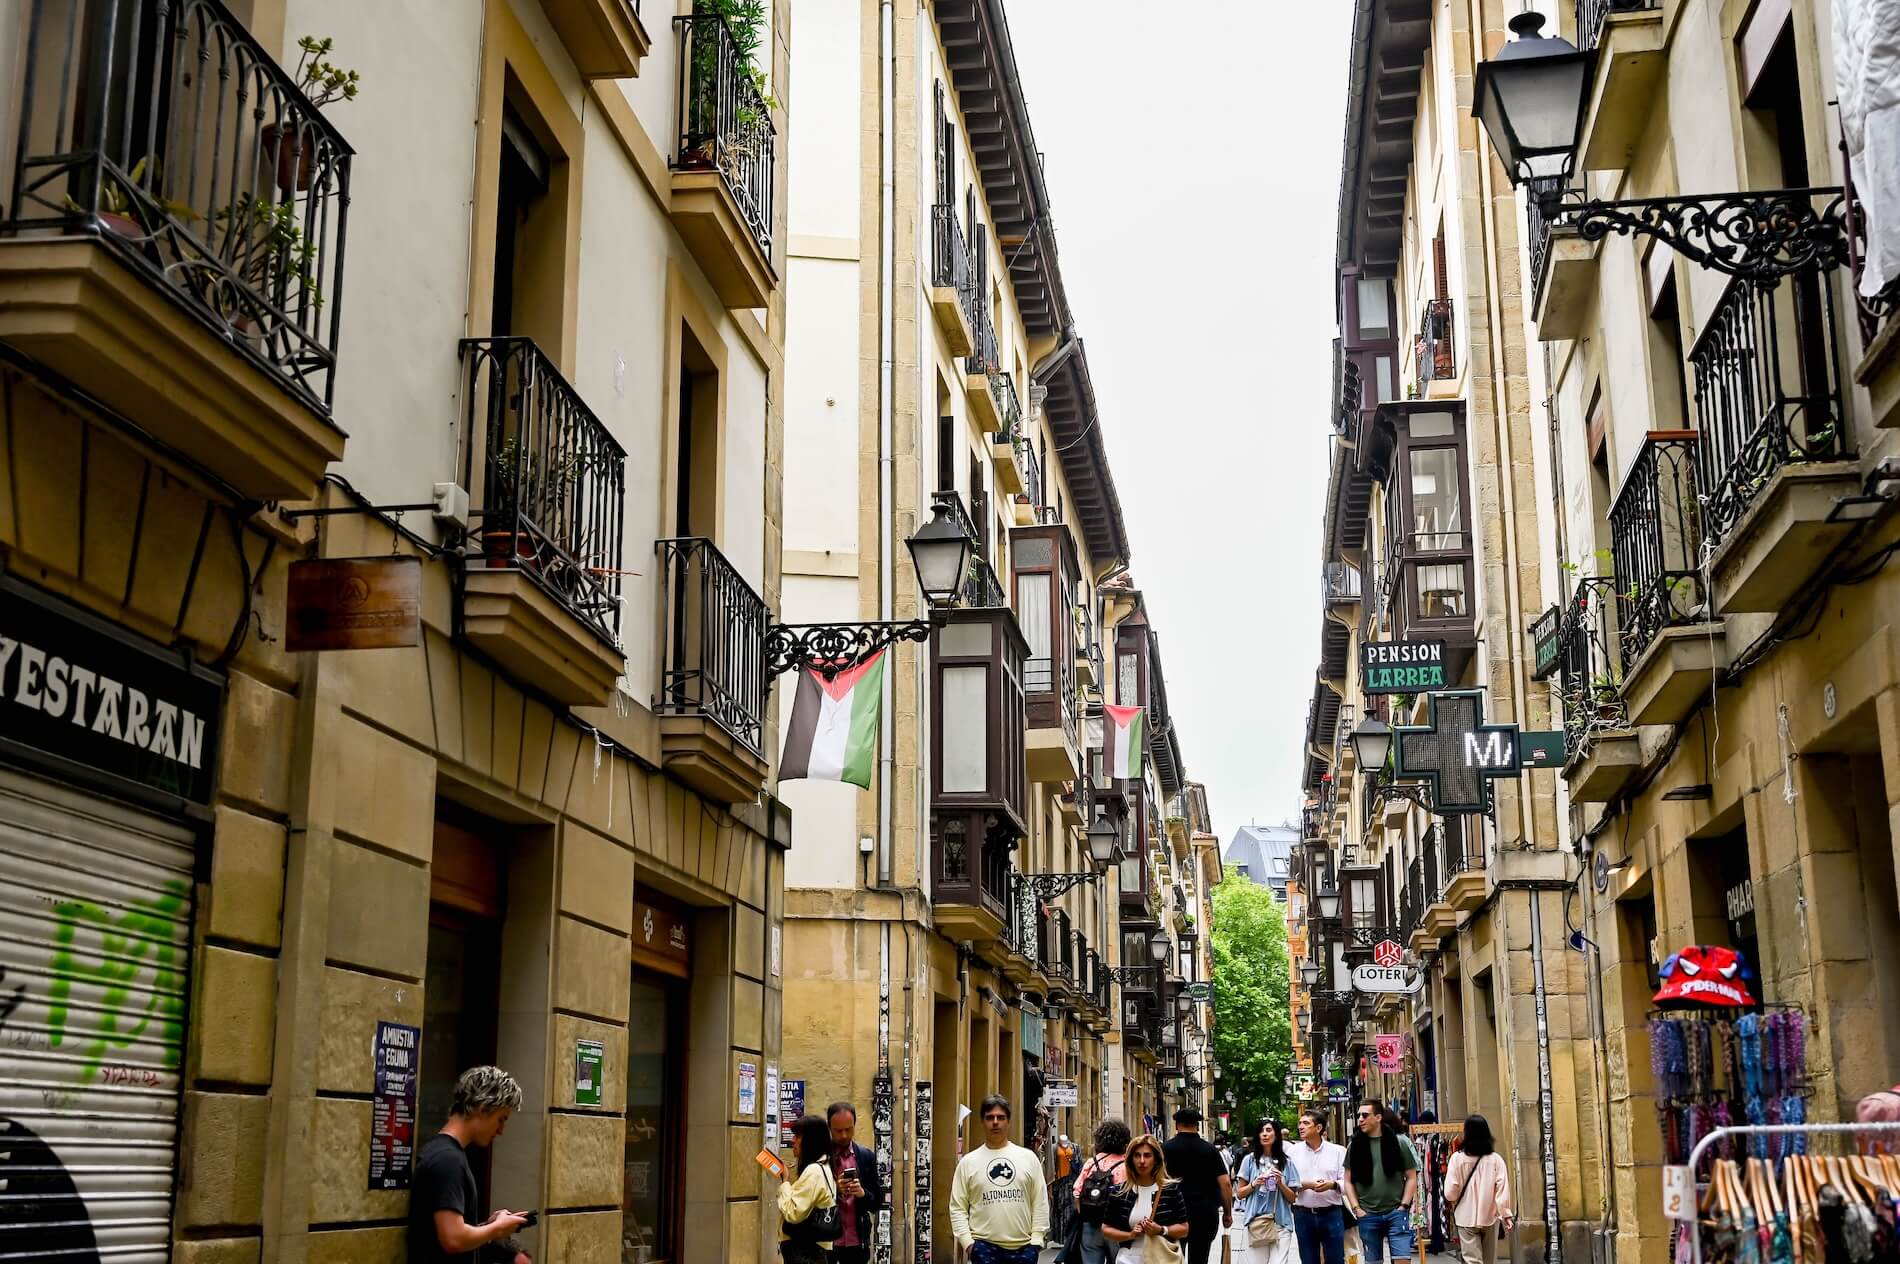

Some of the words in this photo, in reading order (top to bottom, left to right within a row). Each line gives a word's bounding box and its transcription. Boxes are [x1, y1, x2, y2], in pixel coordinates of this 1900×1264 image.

[1367, 666, 1443, 688] LARREA
[382, 1026, 414, 1049] AMNISTIA
[385, 1047, 409, 1068] EGUNA
